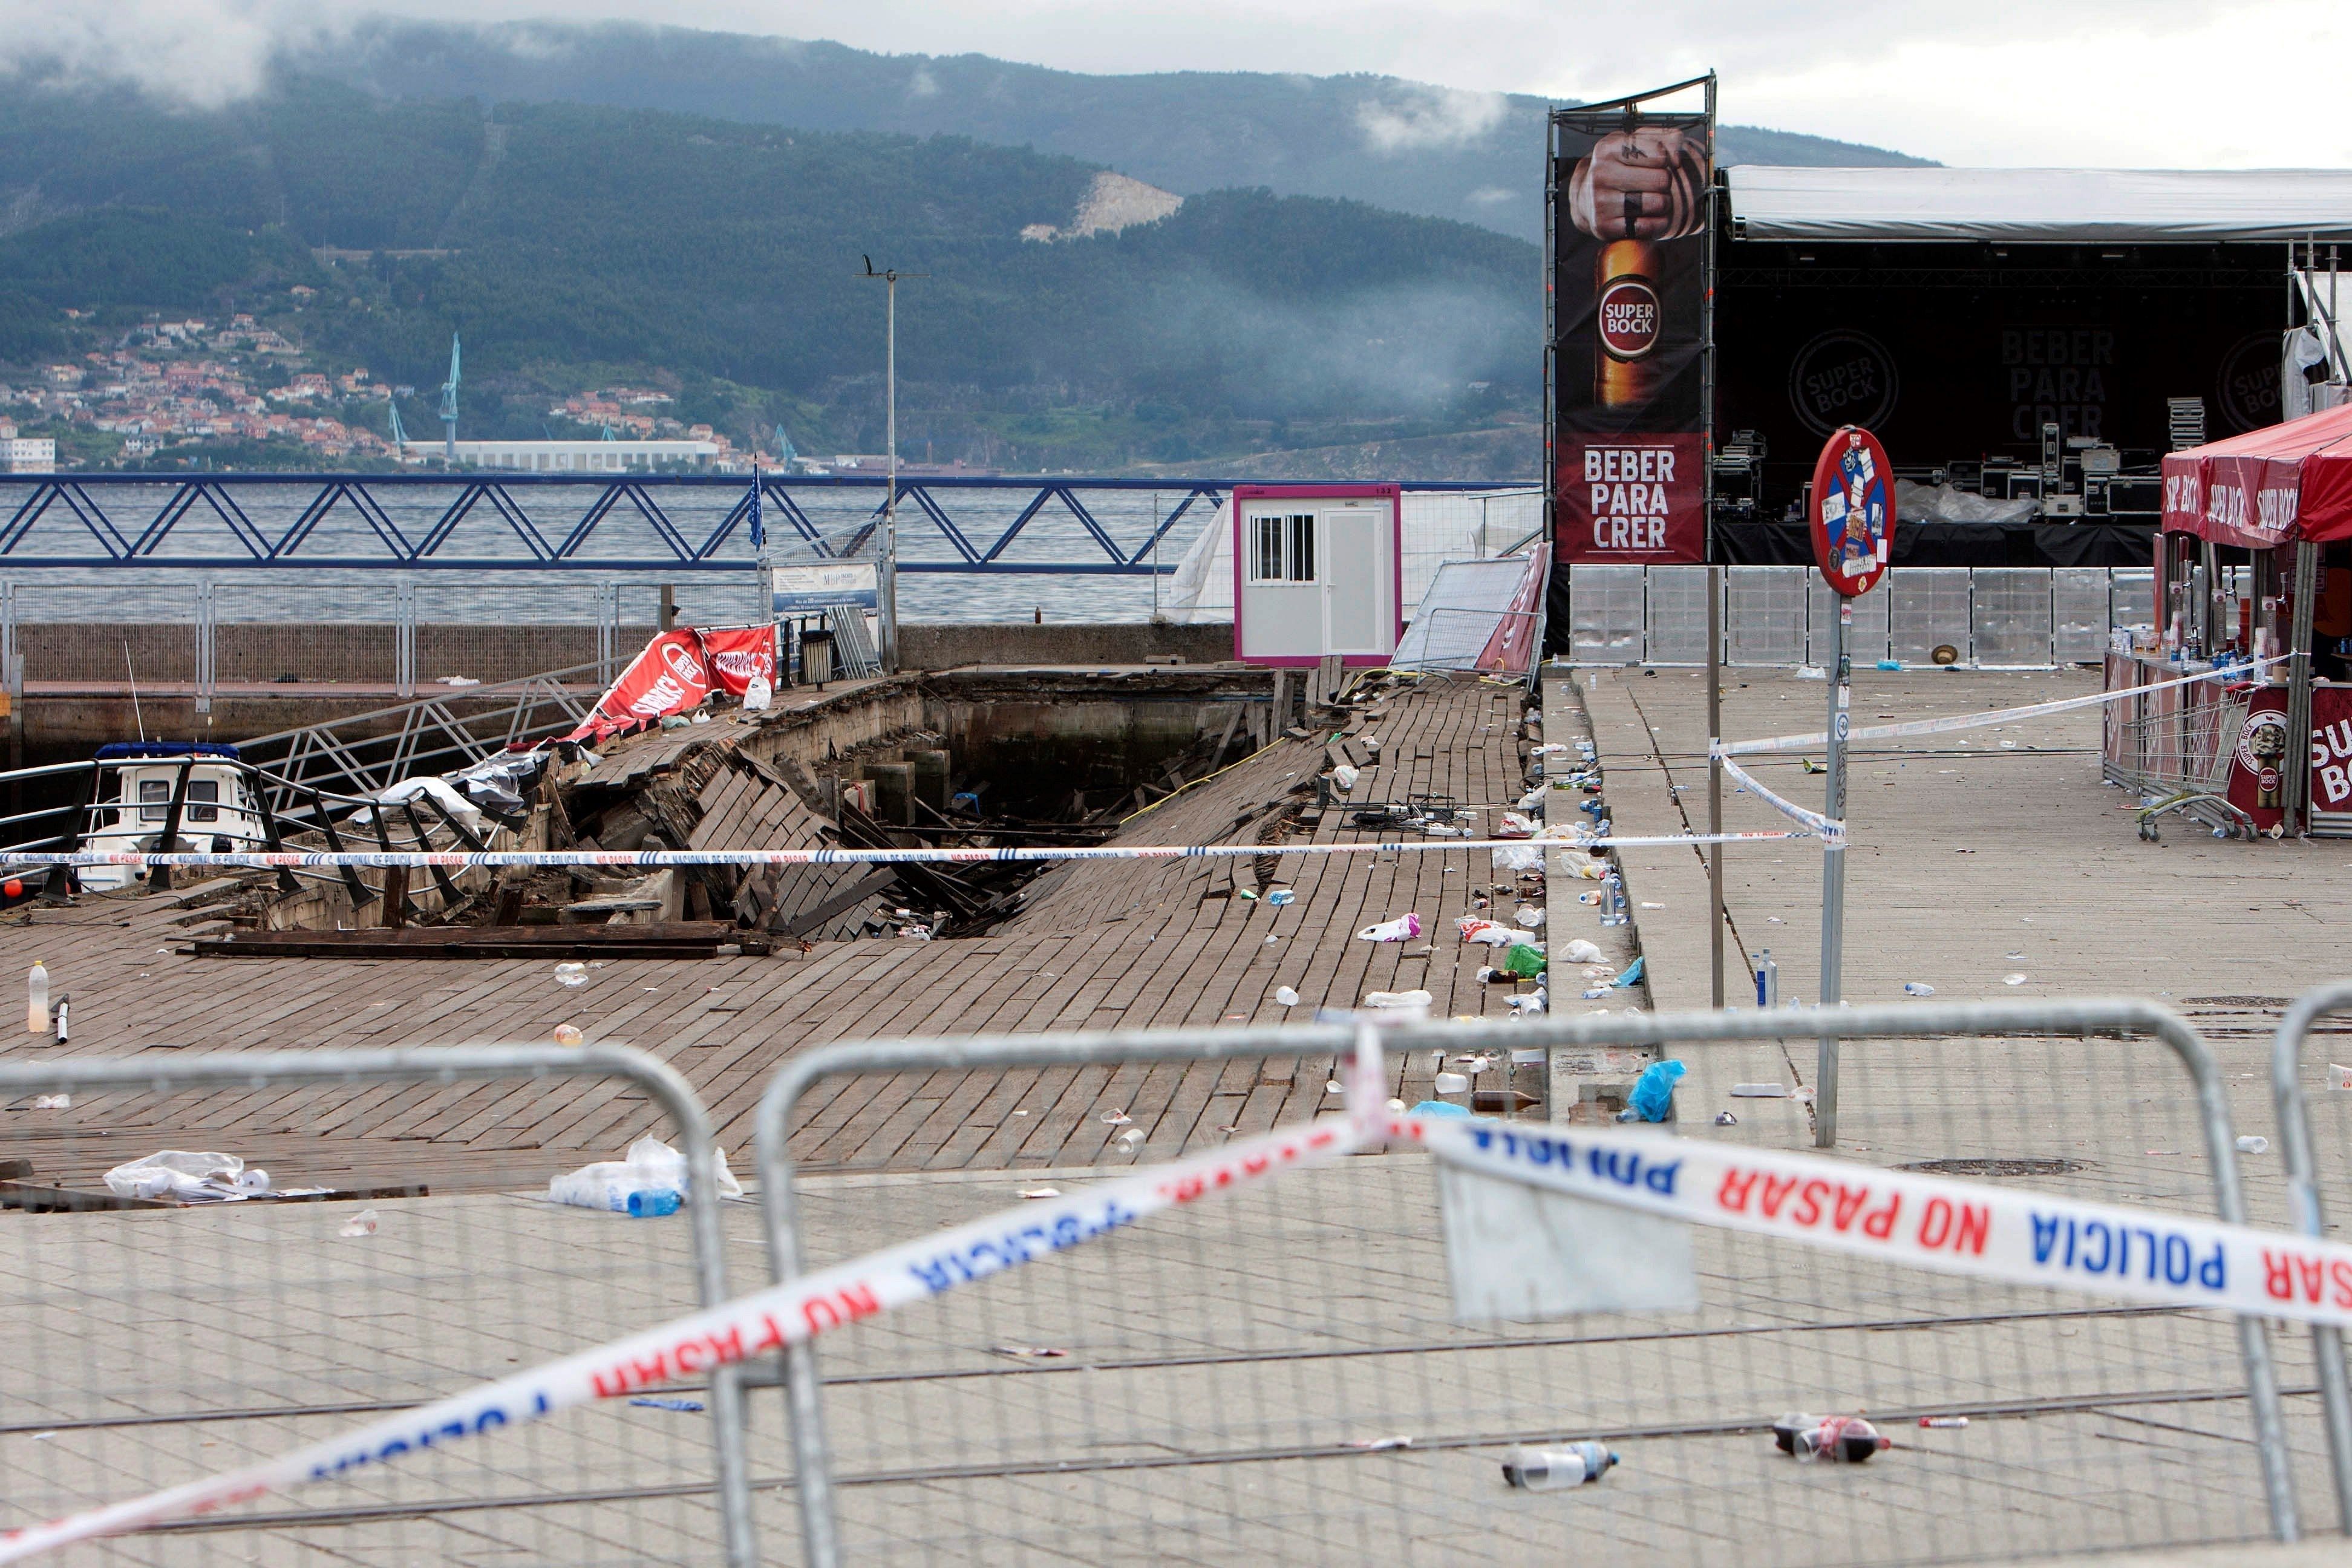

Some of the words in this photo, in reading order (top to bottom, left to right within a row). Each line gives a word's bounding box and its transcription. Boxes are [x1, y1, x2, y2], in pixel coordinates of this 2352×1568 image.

[1606, 304, 1653, 318] SUPER
[1607, 318, 1652, 333] BOCK
[2001, 330, 2114, 365] BEBER
[1805, 357, 1875, 396] SUPER
[2010, 367, 2106, 402] PARA
[2234, 364, 2282, 396] SUP
[1814, 376, 1878, 413] BOCK
[2244, 387, 2282, 415] BO
[1585, 450, 1675, 482] BEBER
[1592, 483, 1669, 514] PARA
[2257, 489, 2277, 529] SUPER
[1593, 517, 1666, 547] CRER
[2242, 722, 2254, 740] BOCK
[2312, 717, 2352, 768] SU
[2240, 745, 2255, 765] SUPER
[1718, 1167, 1903, 1243] PASAR
[1916, 1197, 1991, 1259] NO
[2029, 1212, 2227, 1293] POLICIA
